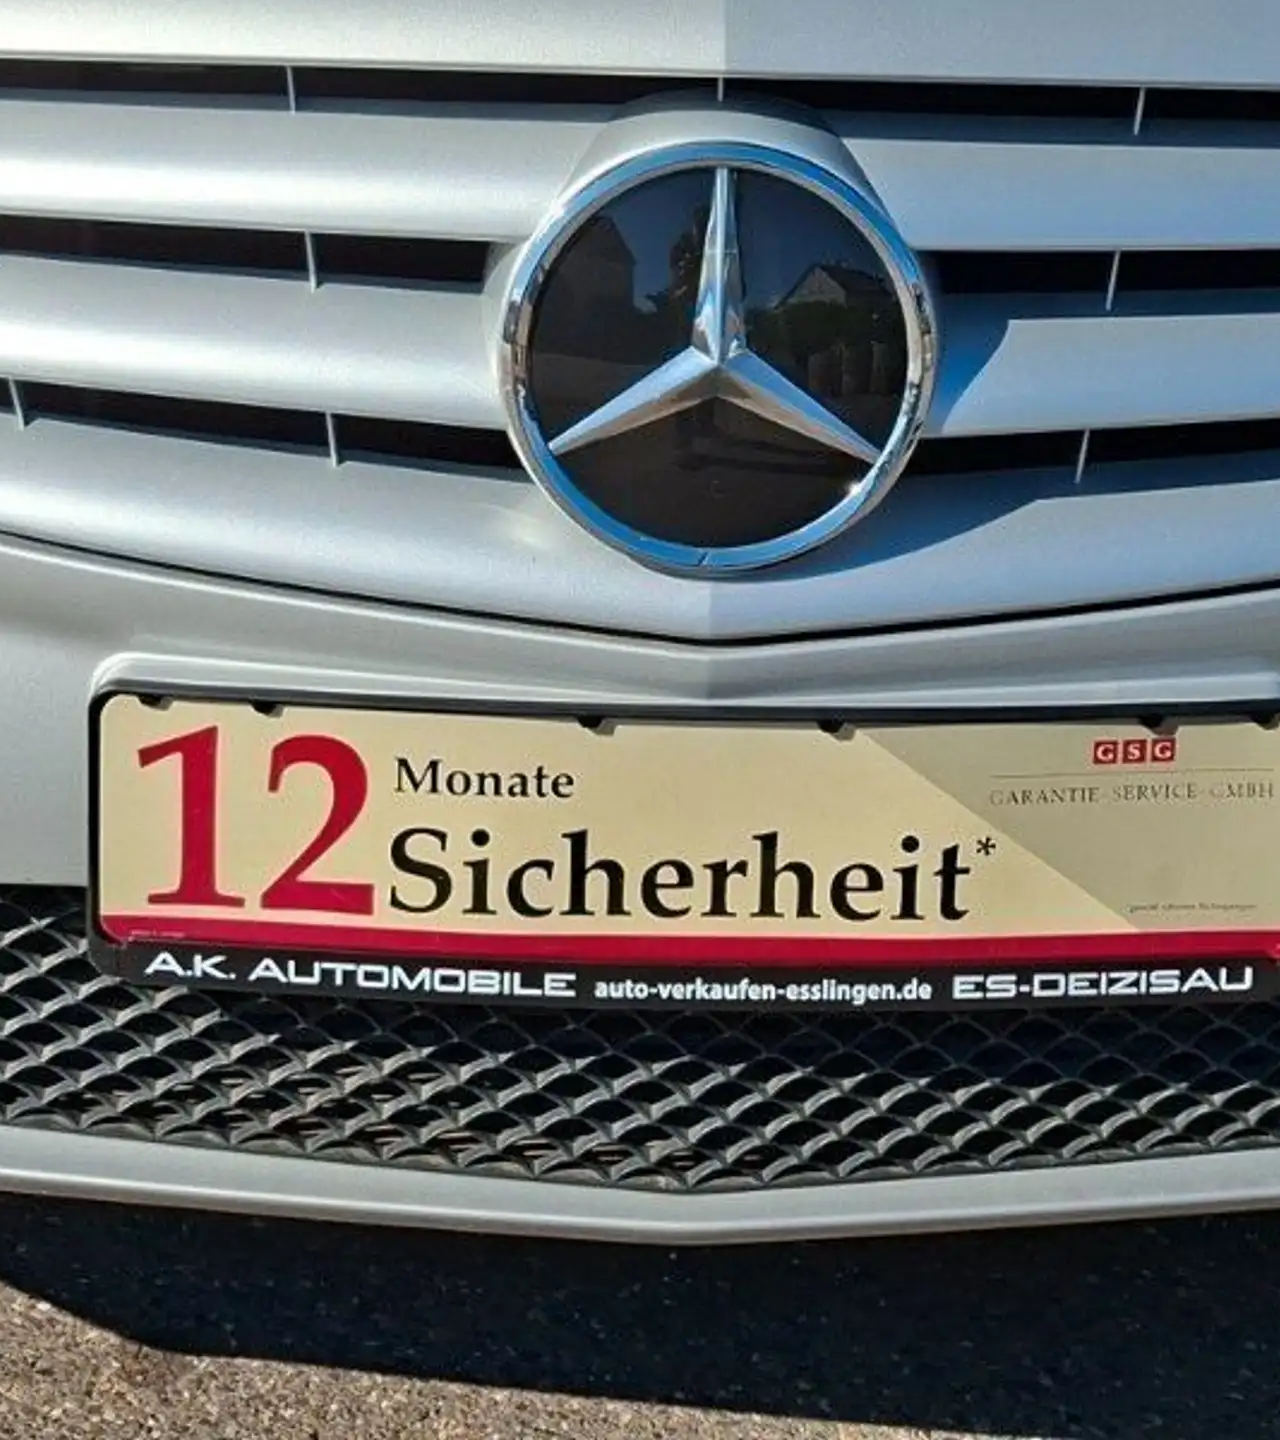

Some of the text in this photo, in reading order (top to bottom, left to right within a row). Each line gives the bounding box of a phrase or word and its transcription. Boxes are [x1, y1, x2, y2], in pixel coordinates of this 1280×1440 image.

[1092, 738, 1177, 765] GSG
[393, 758, 575, 799] Monate
[137, 724, 375, 916] 12
[247, 956, 577, 997] AUTOMOBILE
[594, 972, 932, 1003] auto-verkaufen-esslingen.de
[952, 967, 1254, 1000] ES-DEIZISAU
